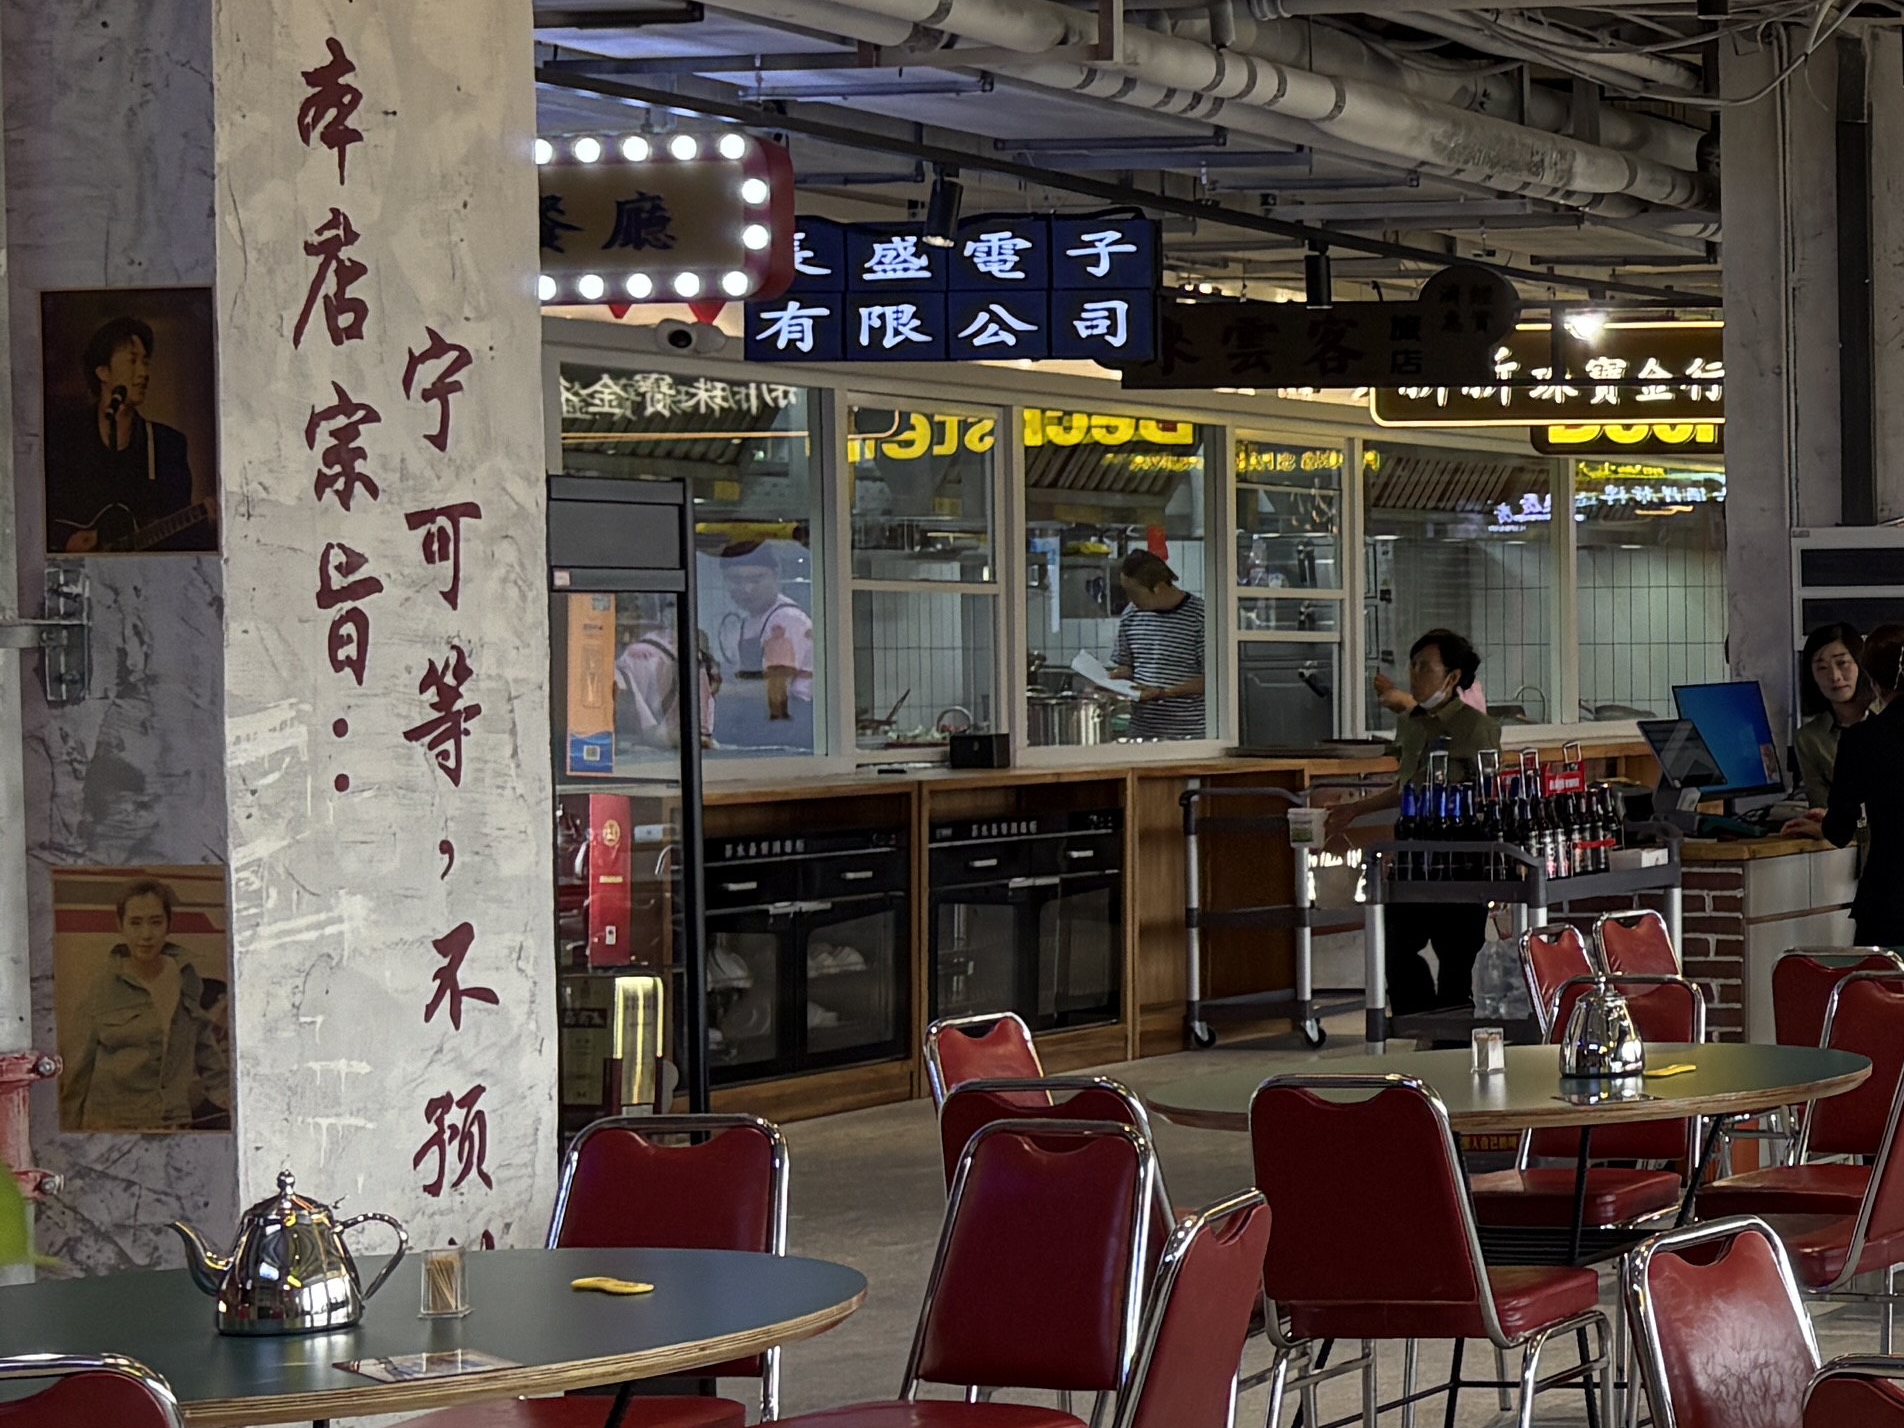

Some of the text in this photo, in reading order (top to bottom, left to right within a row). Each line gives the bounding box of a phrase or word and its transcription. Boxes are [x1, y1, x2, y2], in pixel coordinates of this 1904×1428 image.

[755, 299, 1130, 353] 有限公司
[401, 326, 500, 1249] 宁可等，不预
